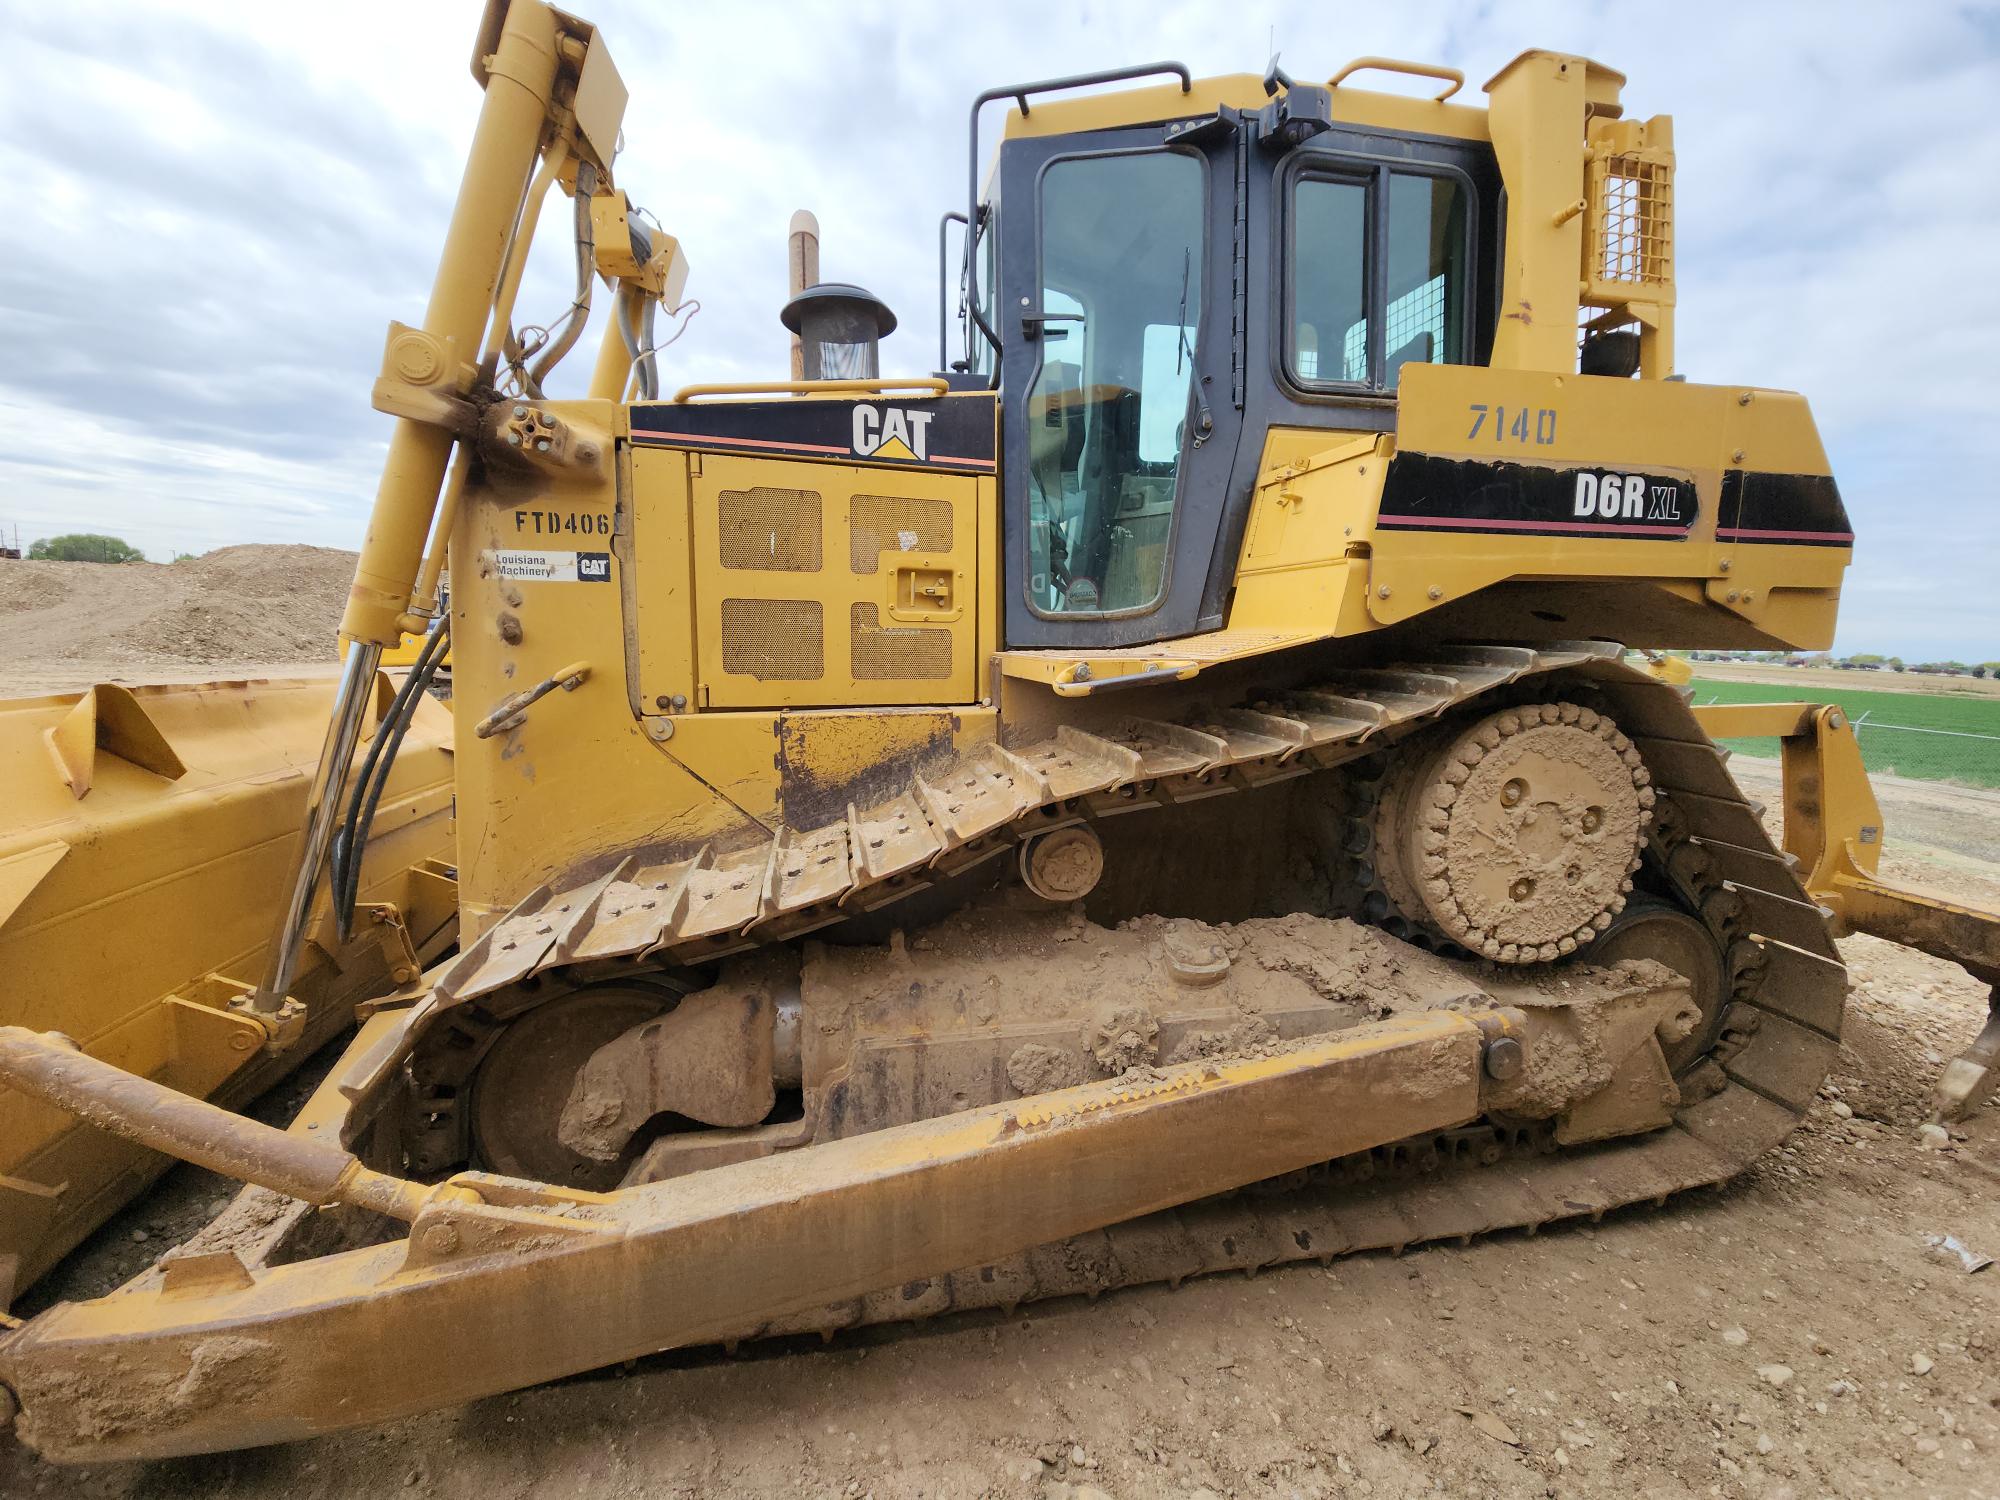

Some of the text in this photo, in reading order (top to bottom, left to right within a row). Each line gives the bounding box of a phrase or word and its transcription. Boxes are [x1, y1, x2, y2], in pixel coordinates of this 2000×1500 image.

[852, 403, 932, 461] CAT
[1468, 404, 1556, 444] 7140
[1574, 472, 1681, 520] D6R XL
[515, 511, 609, 534] FTD406
[496, 553, 546, 565] Louisiana
[580, 558, 608, 575] CAT
[497, 566, 551, 578] Machinery
